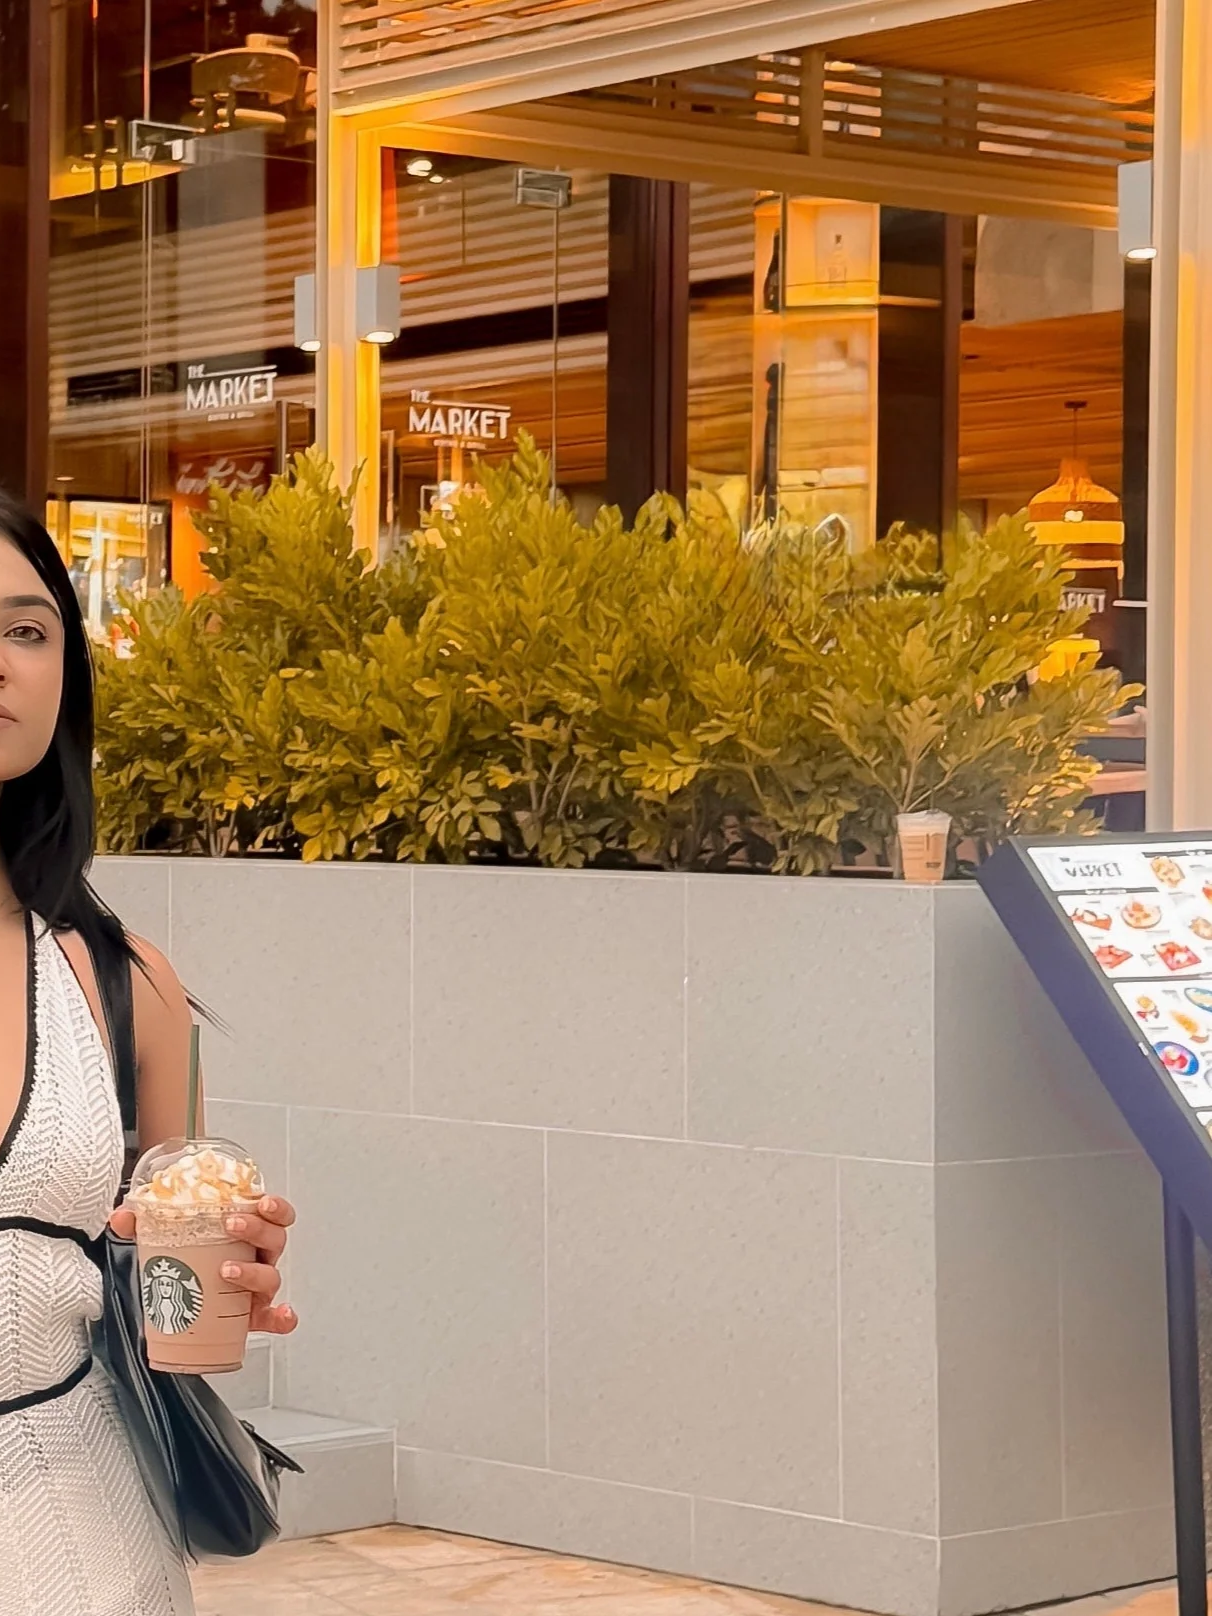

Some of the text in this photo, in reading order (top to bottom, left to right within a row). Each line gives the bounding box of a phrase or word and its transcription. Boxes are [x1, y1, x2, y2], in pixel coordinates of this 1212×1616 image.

[186, 371, 277, 411] MARKET
[408, 405, 511, 439] MARKET
[1057, 592, 1106, 613] ARKET
